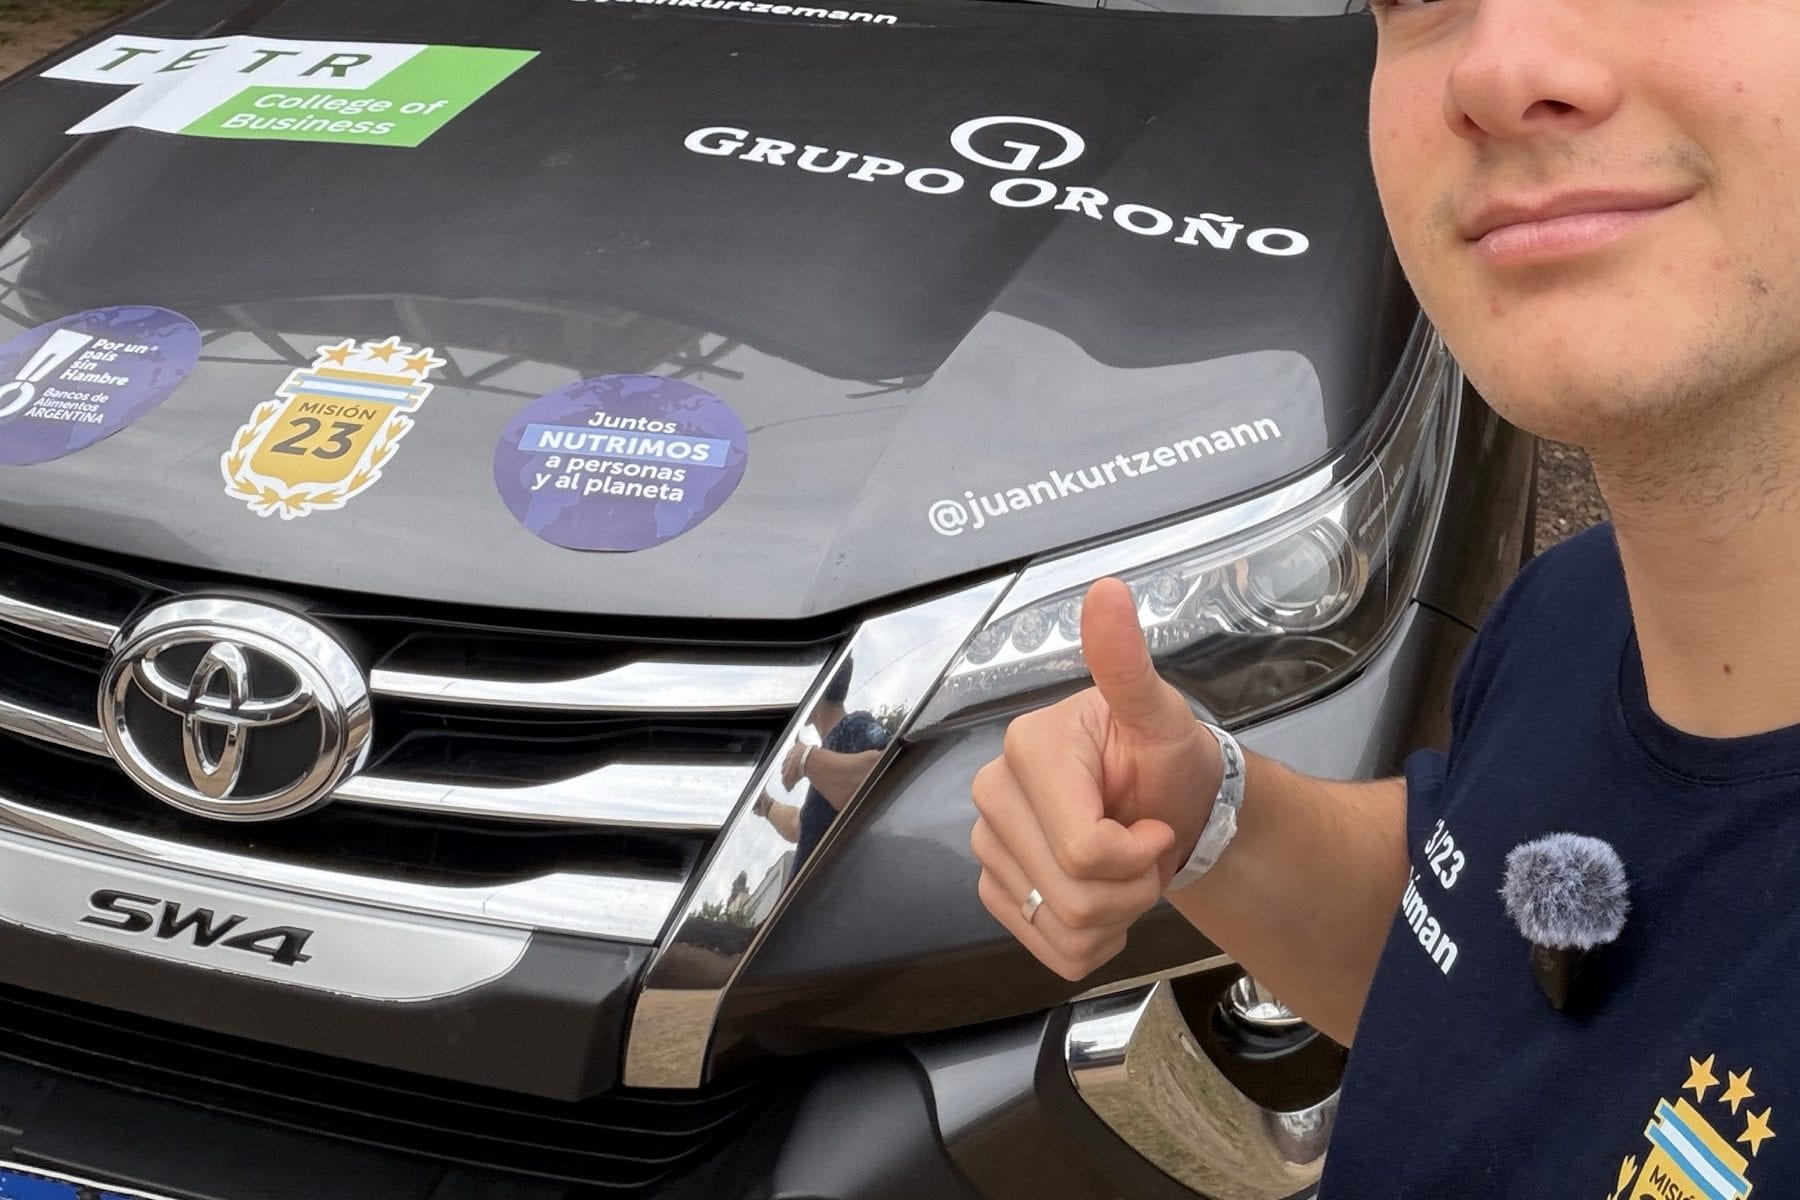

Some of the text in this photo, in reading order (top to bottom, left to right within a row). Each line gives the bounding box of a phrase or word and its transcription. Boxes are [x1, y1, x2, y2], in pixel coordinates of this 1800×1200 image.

[95, 45, 373, 78] TETR
[254, 93, 448, 116] College of
[220, 113, 396, 135] Business
[684, 126, 1310, 257] GRUPO OROÑO
[78, 350, 118, 362] país
[91, 338, 148, 354] Por un
[69, 360, 98, 371] sin
[59, 368, 129, 386] Hambre
[33, 398, 99, 412] Alimentos
[42, 387, 109, 403] Bancos de
[24, 406, 104, 424] ARGENTINA
[298, 402, 377, 421] MISIÓN
[588, 412, 677, 434] Juntos
[270, 417, 364, 459] 23
[538, 430, 711, 462] NUTRIMOS
[545, 456, 686, 482] a personas
[928, 417, 1282, 537] @juankurtzemann
[531, 472, 684, 501] y al planeta
[78, 889, 314, 967] SW4
